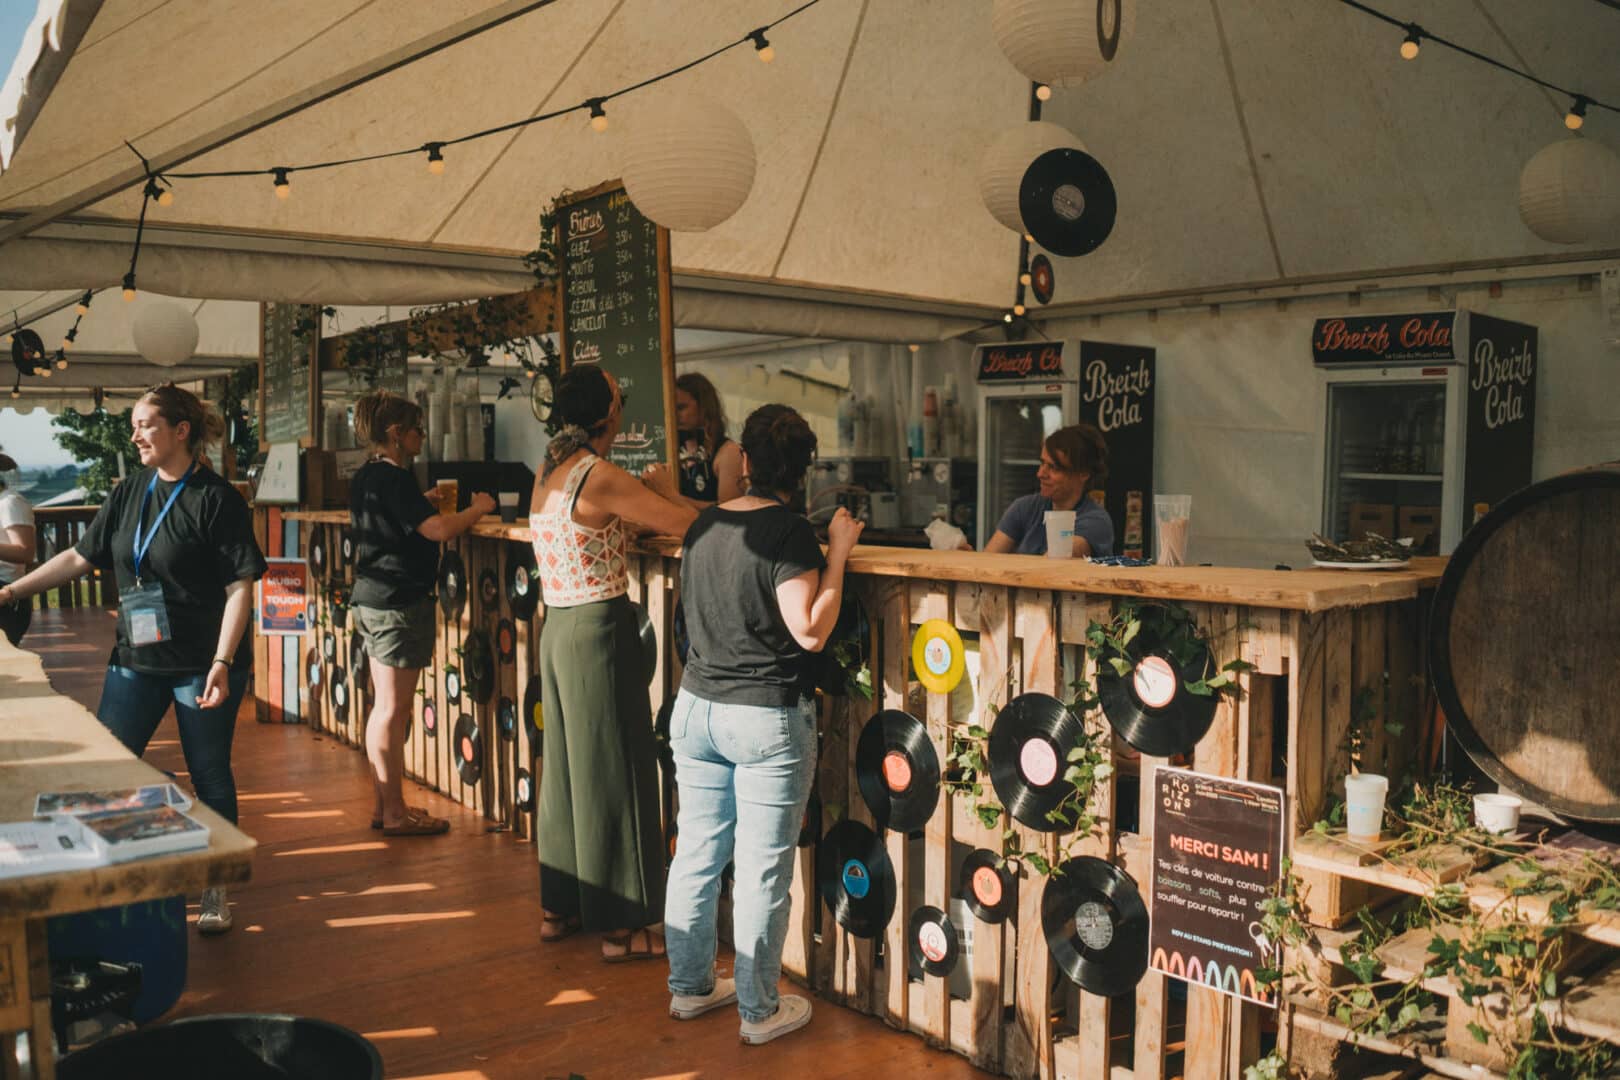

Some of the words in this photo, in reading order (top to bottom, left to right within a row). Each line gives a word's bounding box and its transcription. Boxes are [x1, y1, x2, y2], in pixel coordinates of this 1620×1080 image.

[1316, 319, 1390, 355] Breizh
[1400, 318, 1452, 346] Cola
[1083, 357, 1150, 402] Breizh
[1471, 337, 1532, 391] Breizh
[1098, 396, 1142, 432] Cola
[1485, 384, 1525, 430] Cola
[1170, 834, 1218, 859] MERCI
[1222, 846, 1259, 869] SAM
[1157, 875, 1193, 892] boissons
[1228, 893, 1248, 907] plus
[1158, 858, 1172, 870] Tes
[1173, 862, 1190, 875] clés
[1191, 868, 1203, 879] de
[1204, 871, 1234, 887] voiture
[1236, 878, 1266, 893] contre
[1156, 891, 1187, 907] souffler
[1187, 899, 1208, 912] pour
[1208, 905, 1240, 921] repartir
